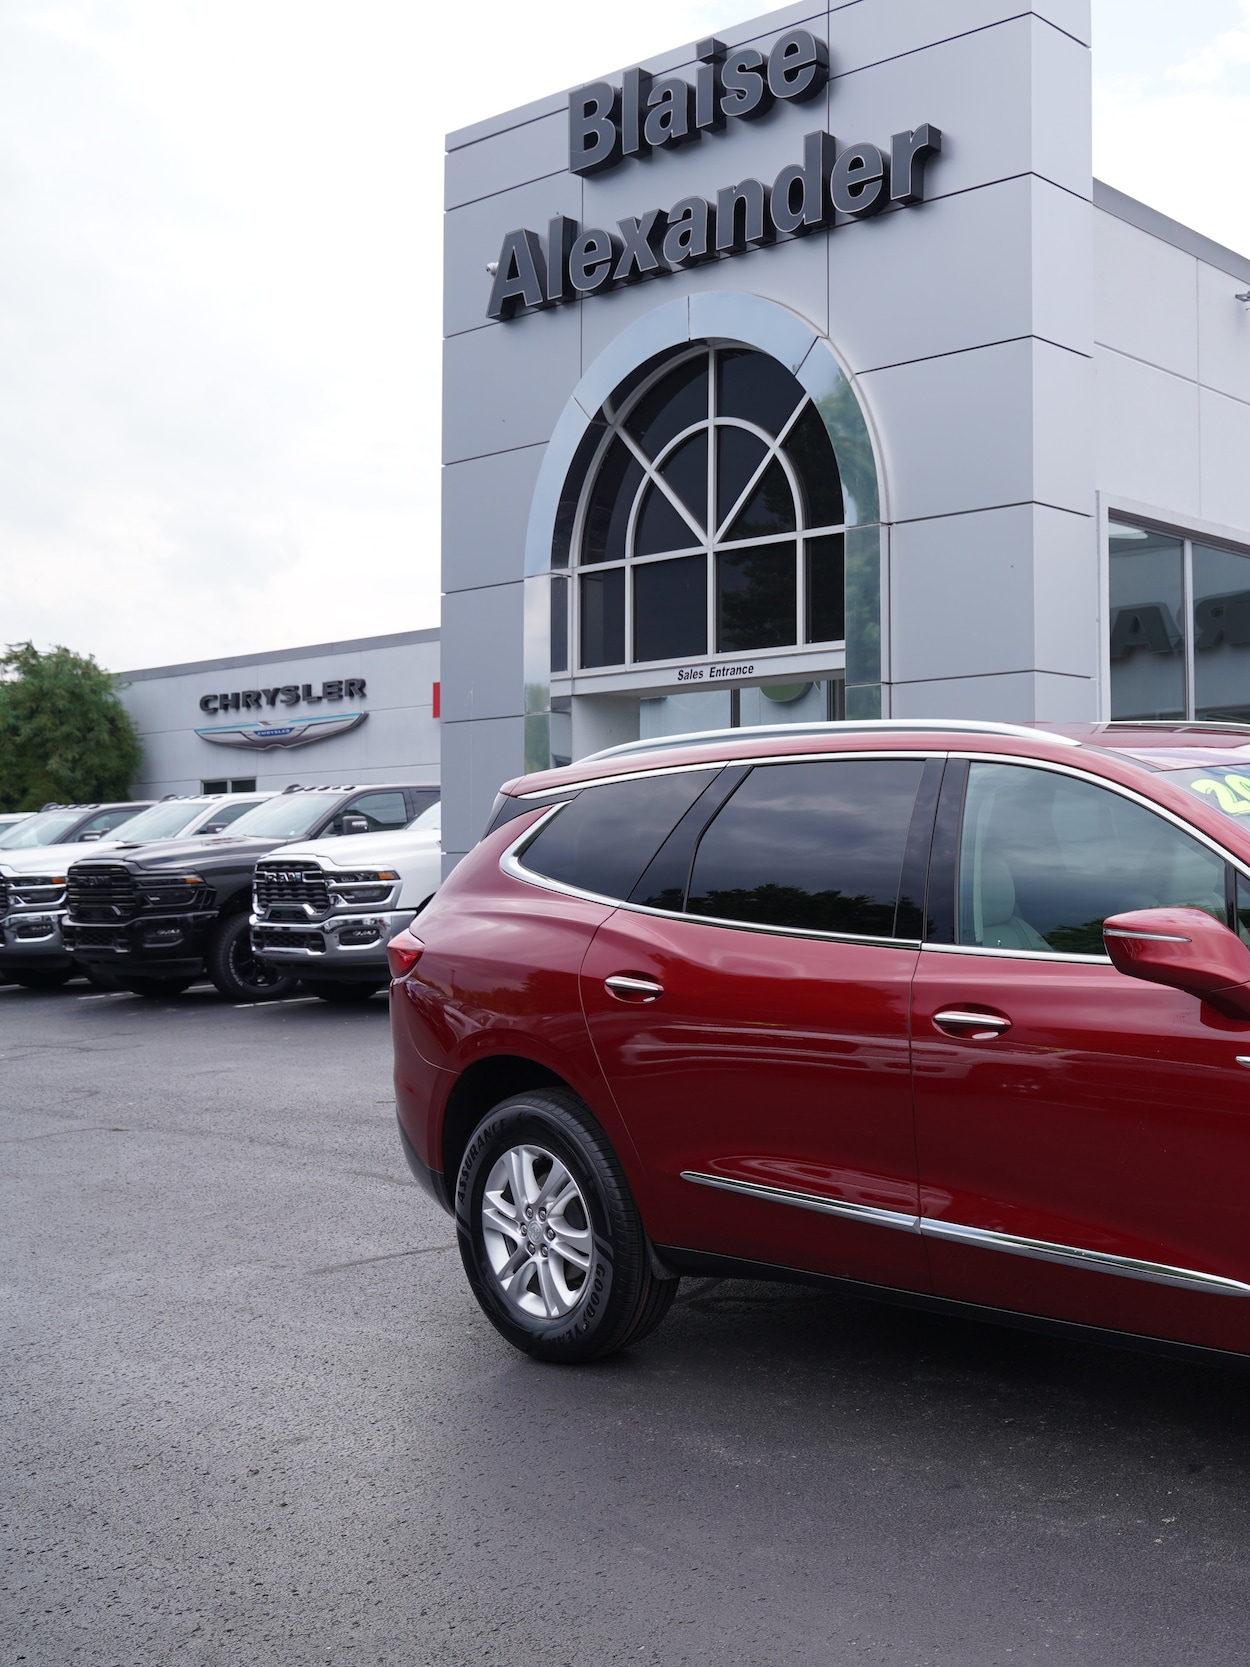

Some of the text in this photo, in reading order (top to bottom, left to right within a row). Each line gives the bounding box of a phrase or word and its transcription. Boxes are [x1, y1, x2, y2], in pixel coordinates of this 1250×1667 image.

[568, 28, 829, 177] Blaise
[486, 123, 942, 322] Alexander
[677, 664, 754, 682] Sales Entrance
[199, 678, 367, 714] CHRYSLER
[264, 871, 302, 883] RAM
